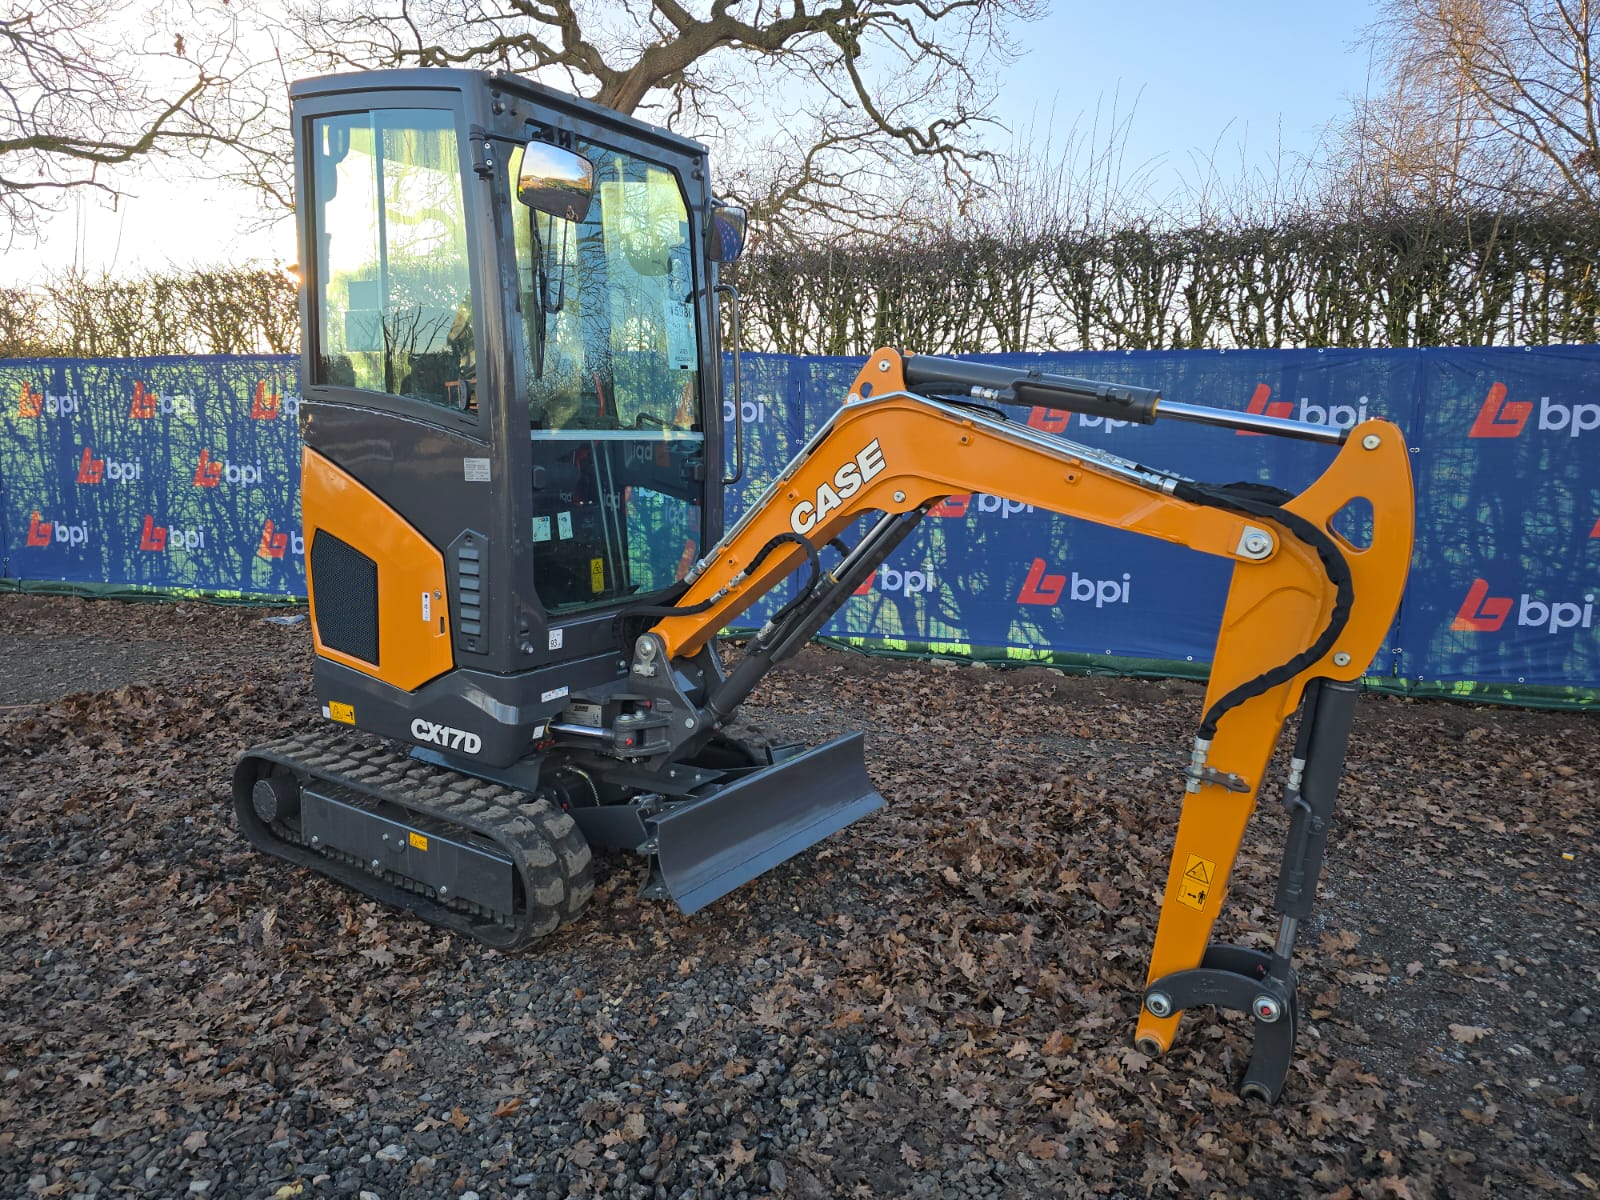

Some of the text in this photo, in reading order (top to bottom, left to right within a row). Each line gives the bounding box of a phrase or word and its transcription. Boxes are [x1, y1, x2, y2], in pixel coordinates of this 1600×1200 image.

[45, 390, 79, 417] bpi
[160, 390, 195, 418] bpi
[106, 457, 140, 484] bpi
[225, 460, 262, 487] bpi
[790, 438, 887, 535] CASE
[54, 521, 89, 546] bpi
[169, 525, 205, 552] bpi
[881, 564, 934, 597] bpi
[1071, 573, 1131, 608] bpi
[1518, 594, 1593, 634] bpi
[410, 718, 482, 755] CX17D
